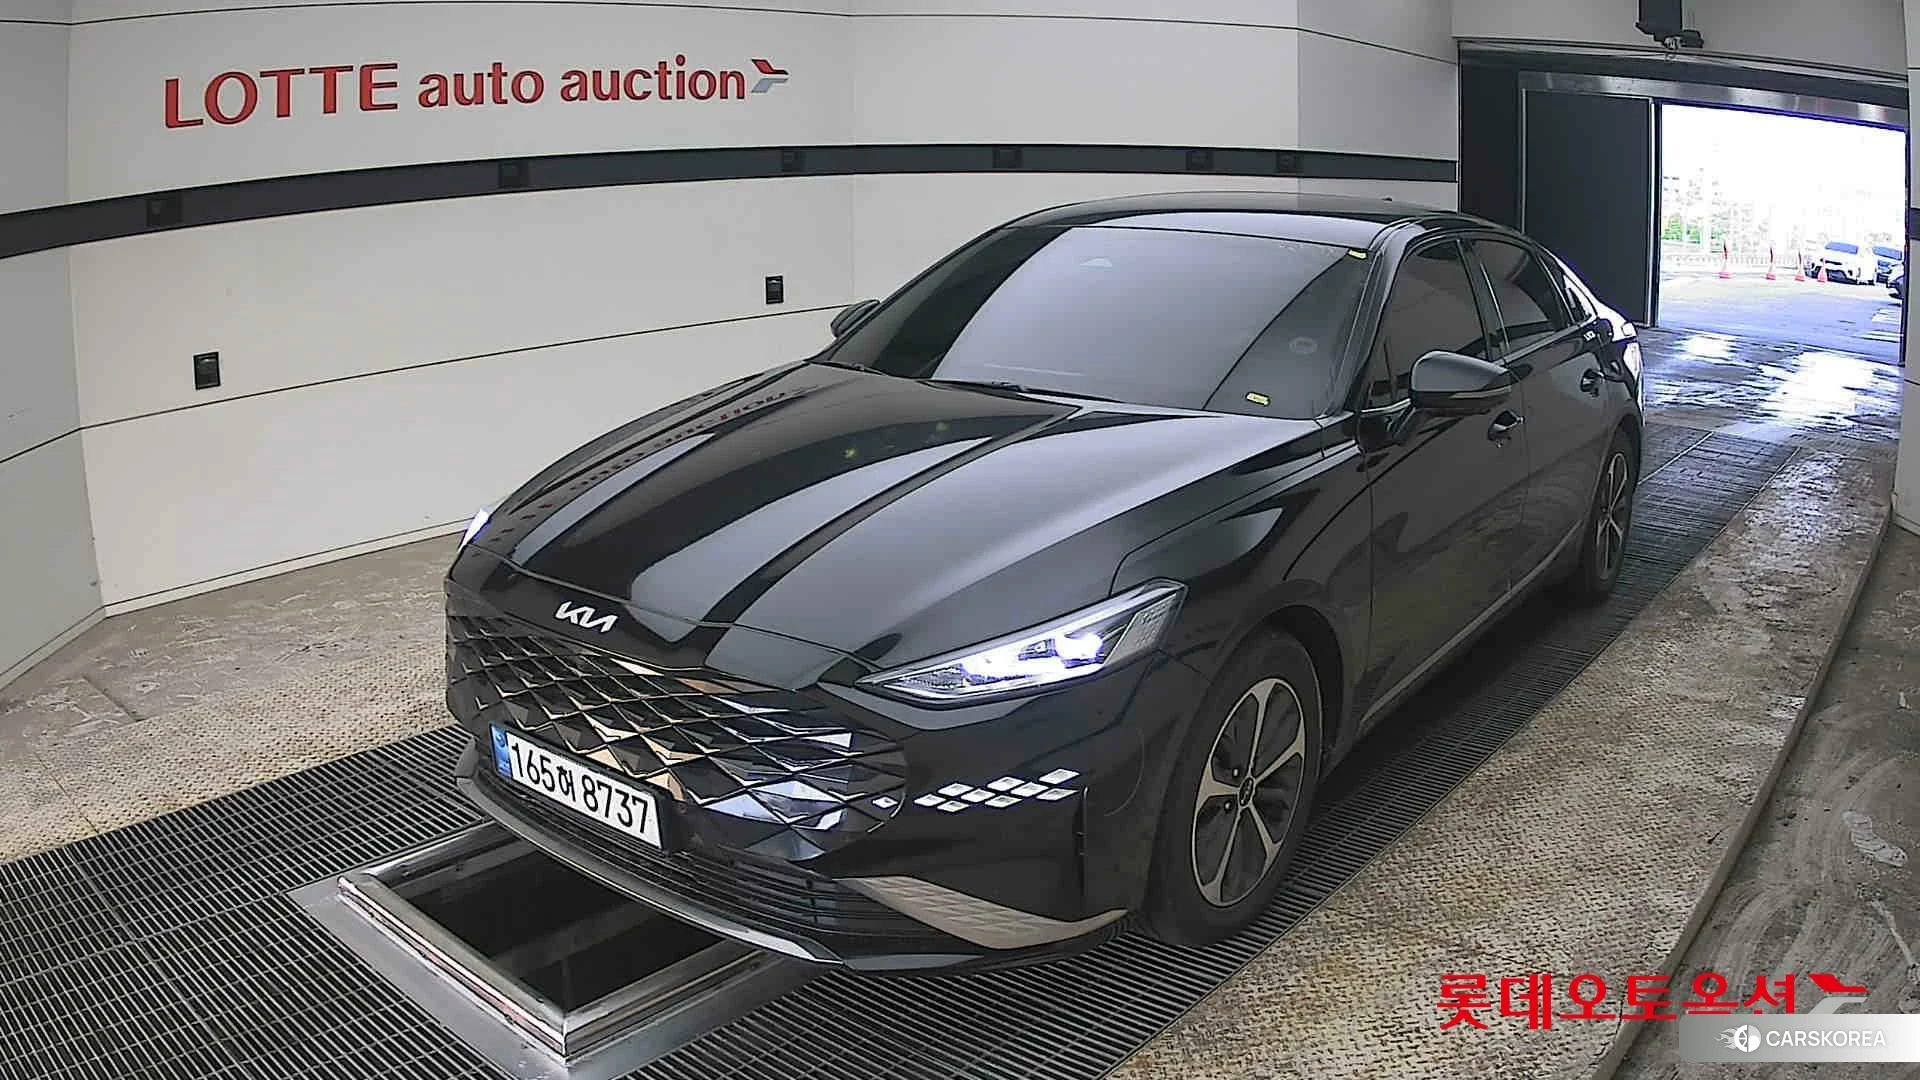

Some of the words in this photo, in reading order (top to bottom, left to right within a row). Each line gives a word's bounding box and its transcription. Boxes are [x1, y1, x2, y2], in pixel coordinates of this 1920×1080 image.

[165, 60, 400, 129] LOTTE
[418, 61, 545, 109] auto
[560, 54, 746, 101] auction
[582, 774, 648, 833] 8737
